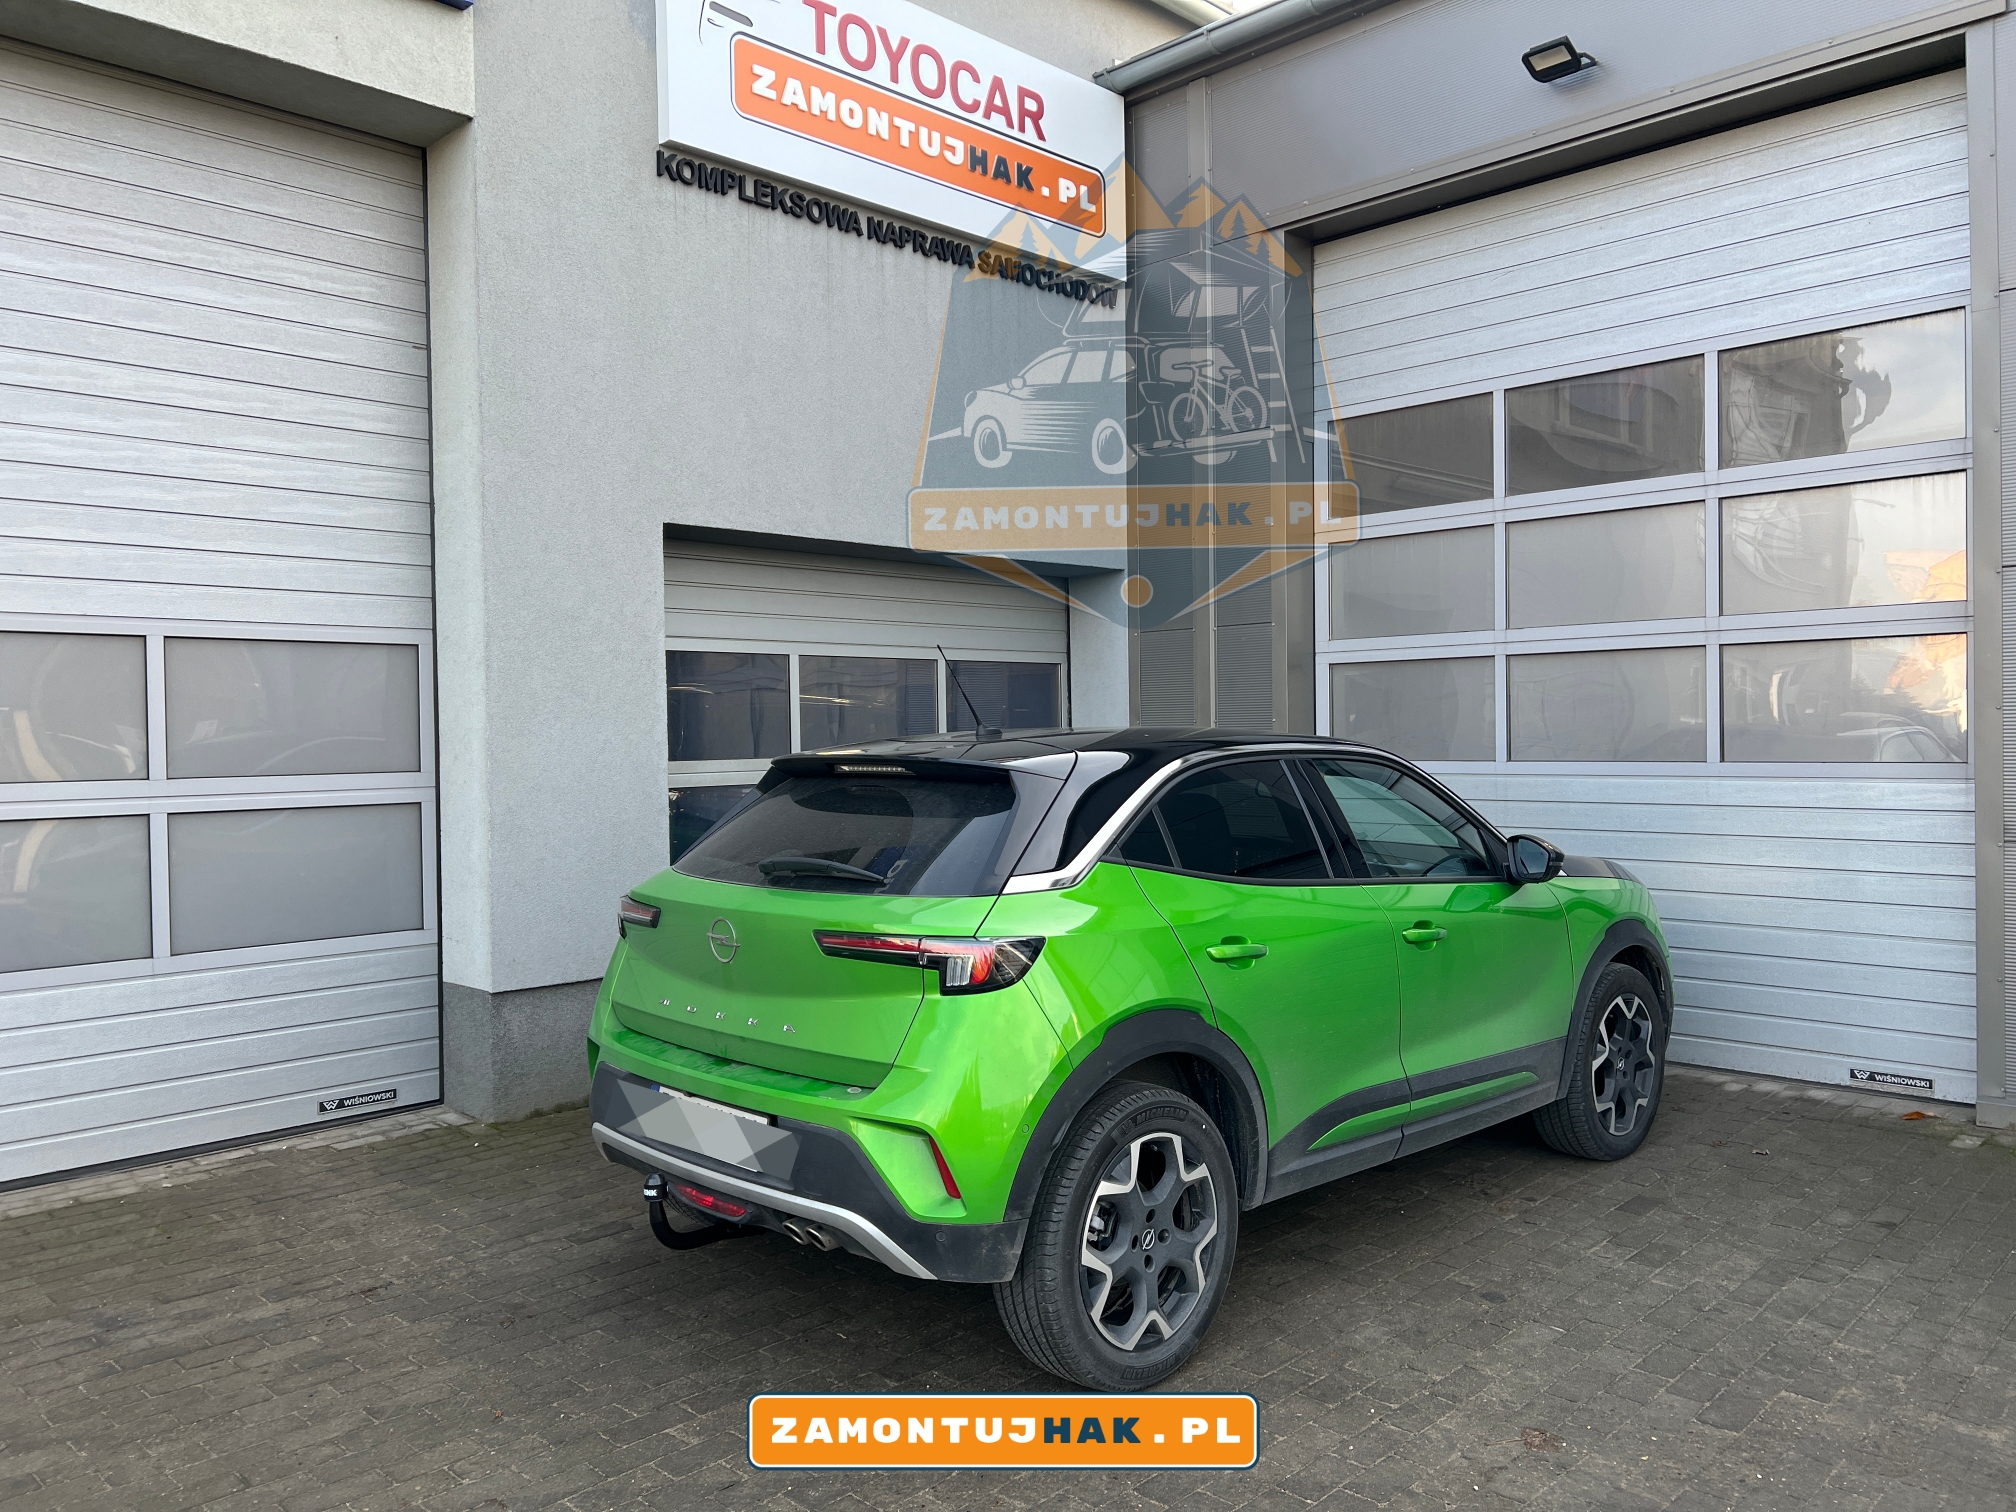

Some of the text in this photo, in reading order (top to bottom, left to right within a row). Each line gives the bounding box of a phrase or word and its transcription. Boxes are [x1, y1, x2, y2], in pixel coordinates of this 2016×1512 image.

[803, 0, 1047, 142] TOYOCAR
[656, 149, 866, 237] KOMPLEKSOWA
[866, 216, 976, 270] NAPRAWA
[1874, 1074, 1929, 1088] WIŚNIOWSKI
[343, 1091, 394, 1107] WIŚNIOWSKI
[1137, 1107, 1187, 1125] MICHELIN
